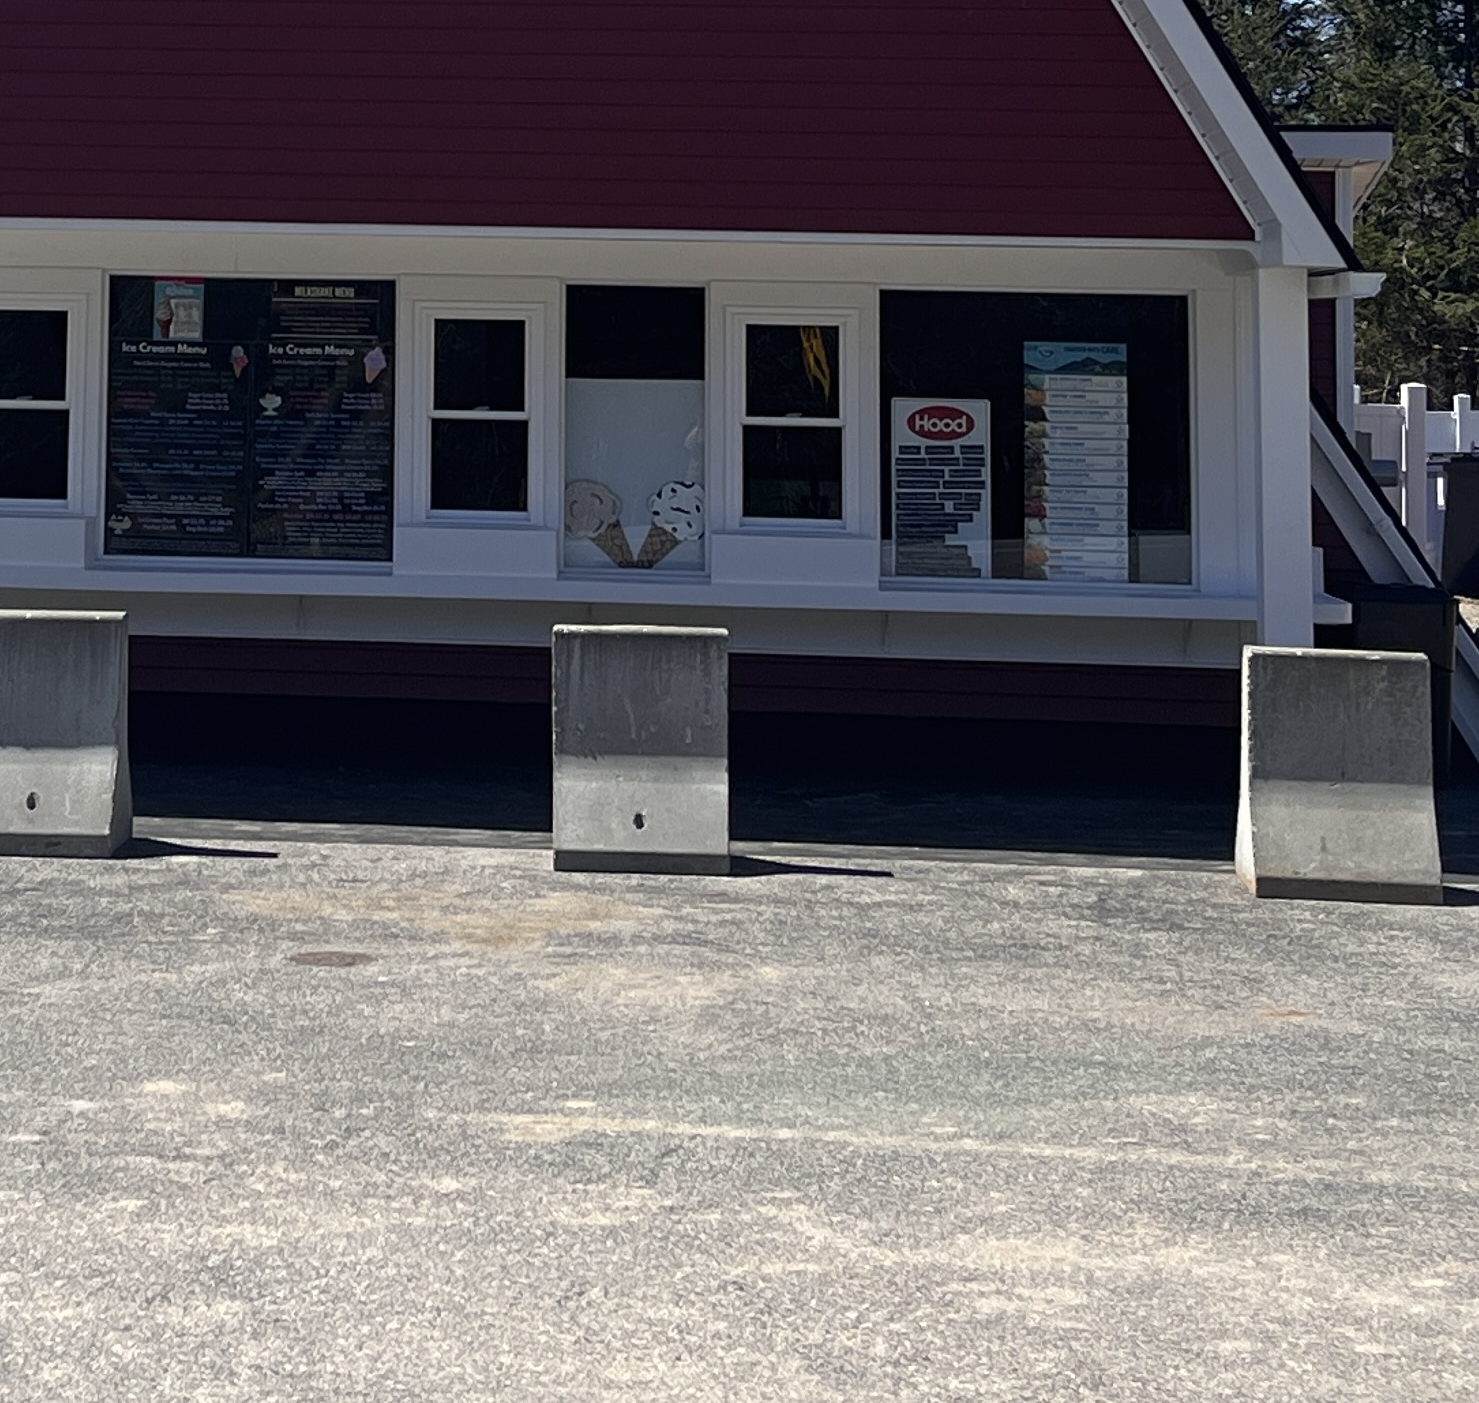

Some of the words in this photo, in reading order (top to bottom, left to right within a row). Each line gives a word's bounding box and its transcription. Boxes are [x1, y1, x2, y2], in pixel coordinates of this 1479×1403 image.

[121, 342, 137, 353] Ice
[138, 342, 176, 354] Cream
[176, 343, 208, 355] Menu
[268, 343, 284, 355] Ice
[285, 343, 323, 355] Cream
[324, 344, 355, 356] Menu
[914, 413, 967, 433] Hood
